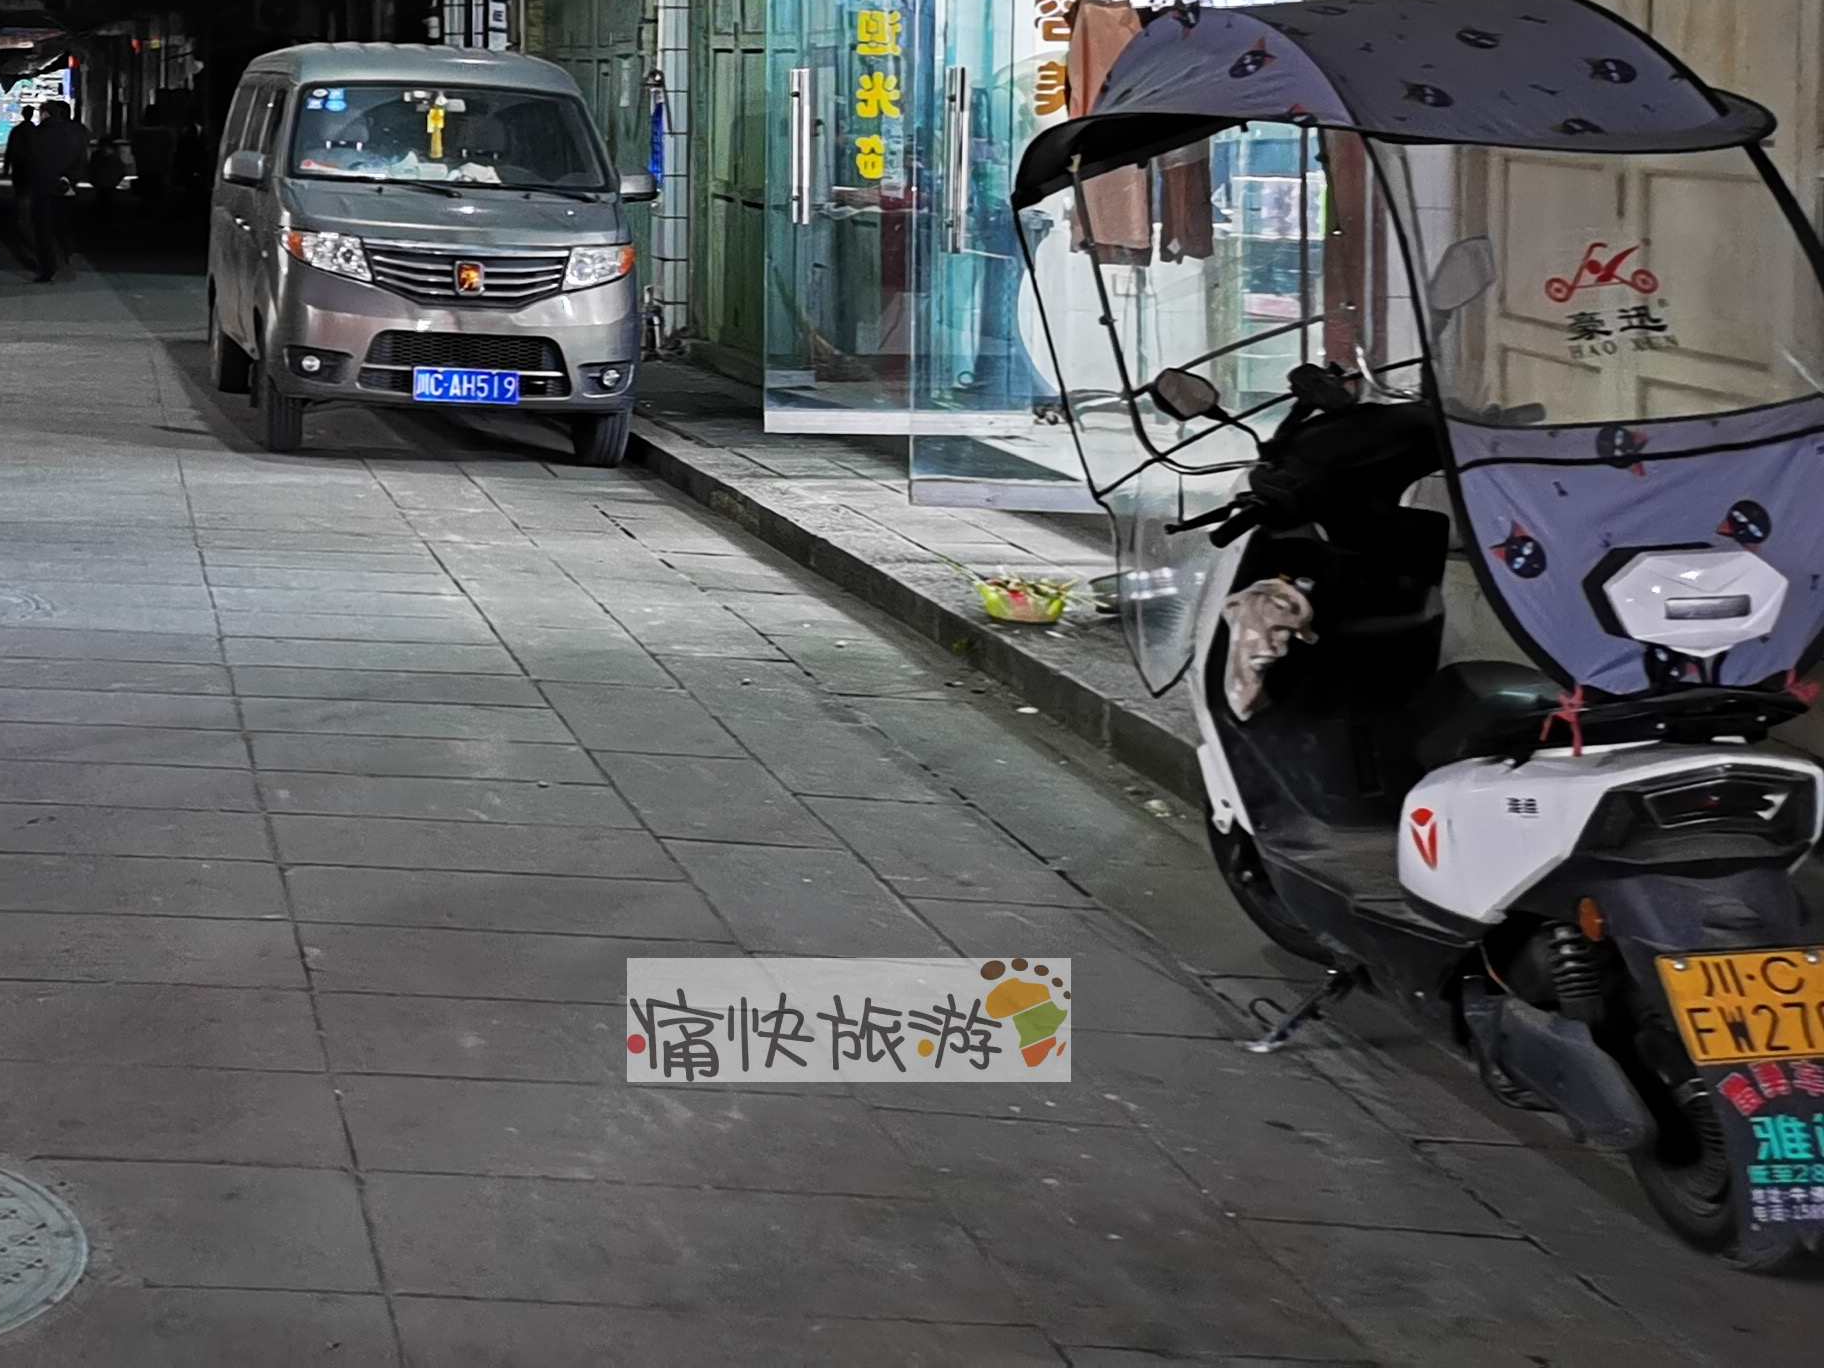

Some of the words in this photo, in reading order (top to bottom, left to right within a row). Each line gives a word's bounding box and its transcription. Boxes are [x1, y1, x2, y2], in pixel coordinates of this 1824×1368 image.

[1566, 305, 1668, 340] 豪迅
[1686, 1002, 1824, 1056] FW27
[1749, 1113, 1824, 1161] 雅
